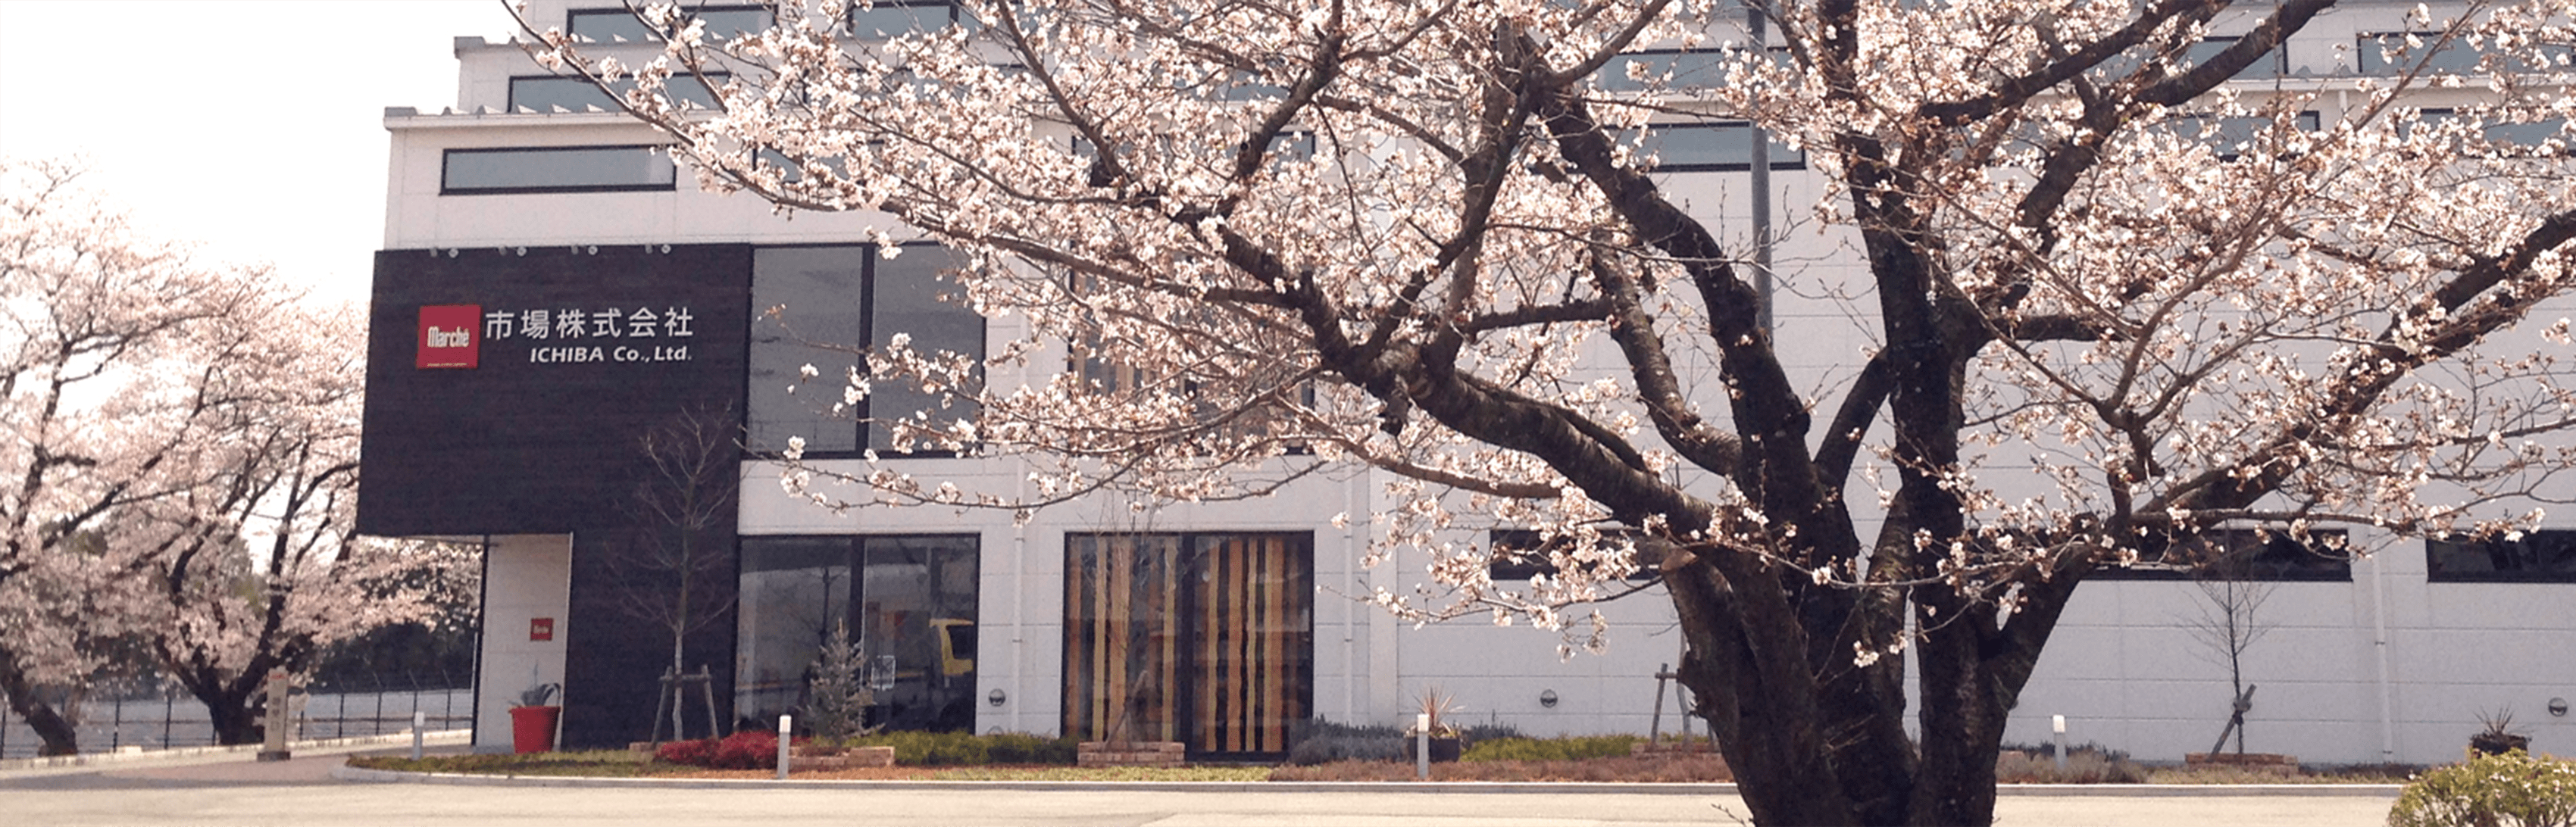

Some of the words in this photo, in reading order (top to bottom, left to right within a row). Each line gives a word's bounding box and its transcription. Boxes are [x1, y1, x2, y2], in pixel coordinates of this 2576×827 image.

[485, 306, 694, 341] 市場株式会社
[530, 346, 605, 364] ICHIBA
